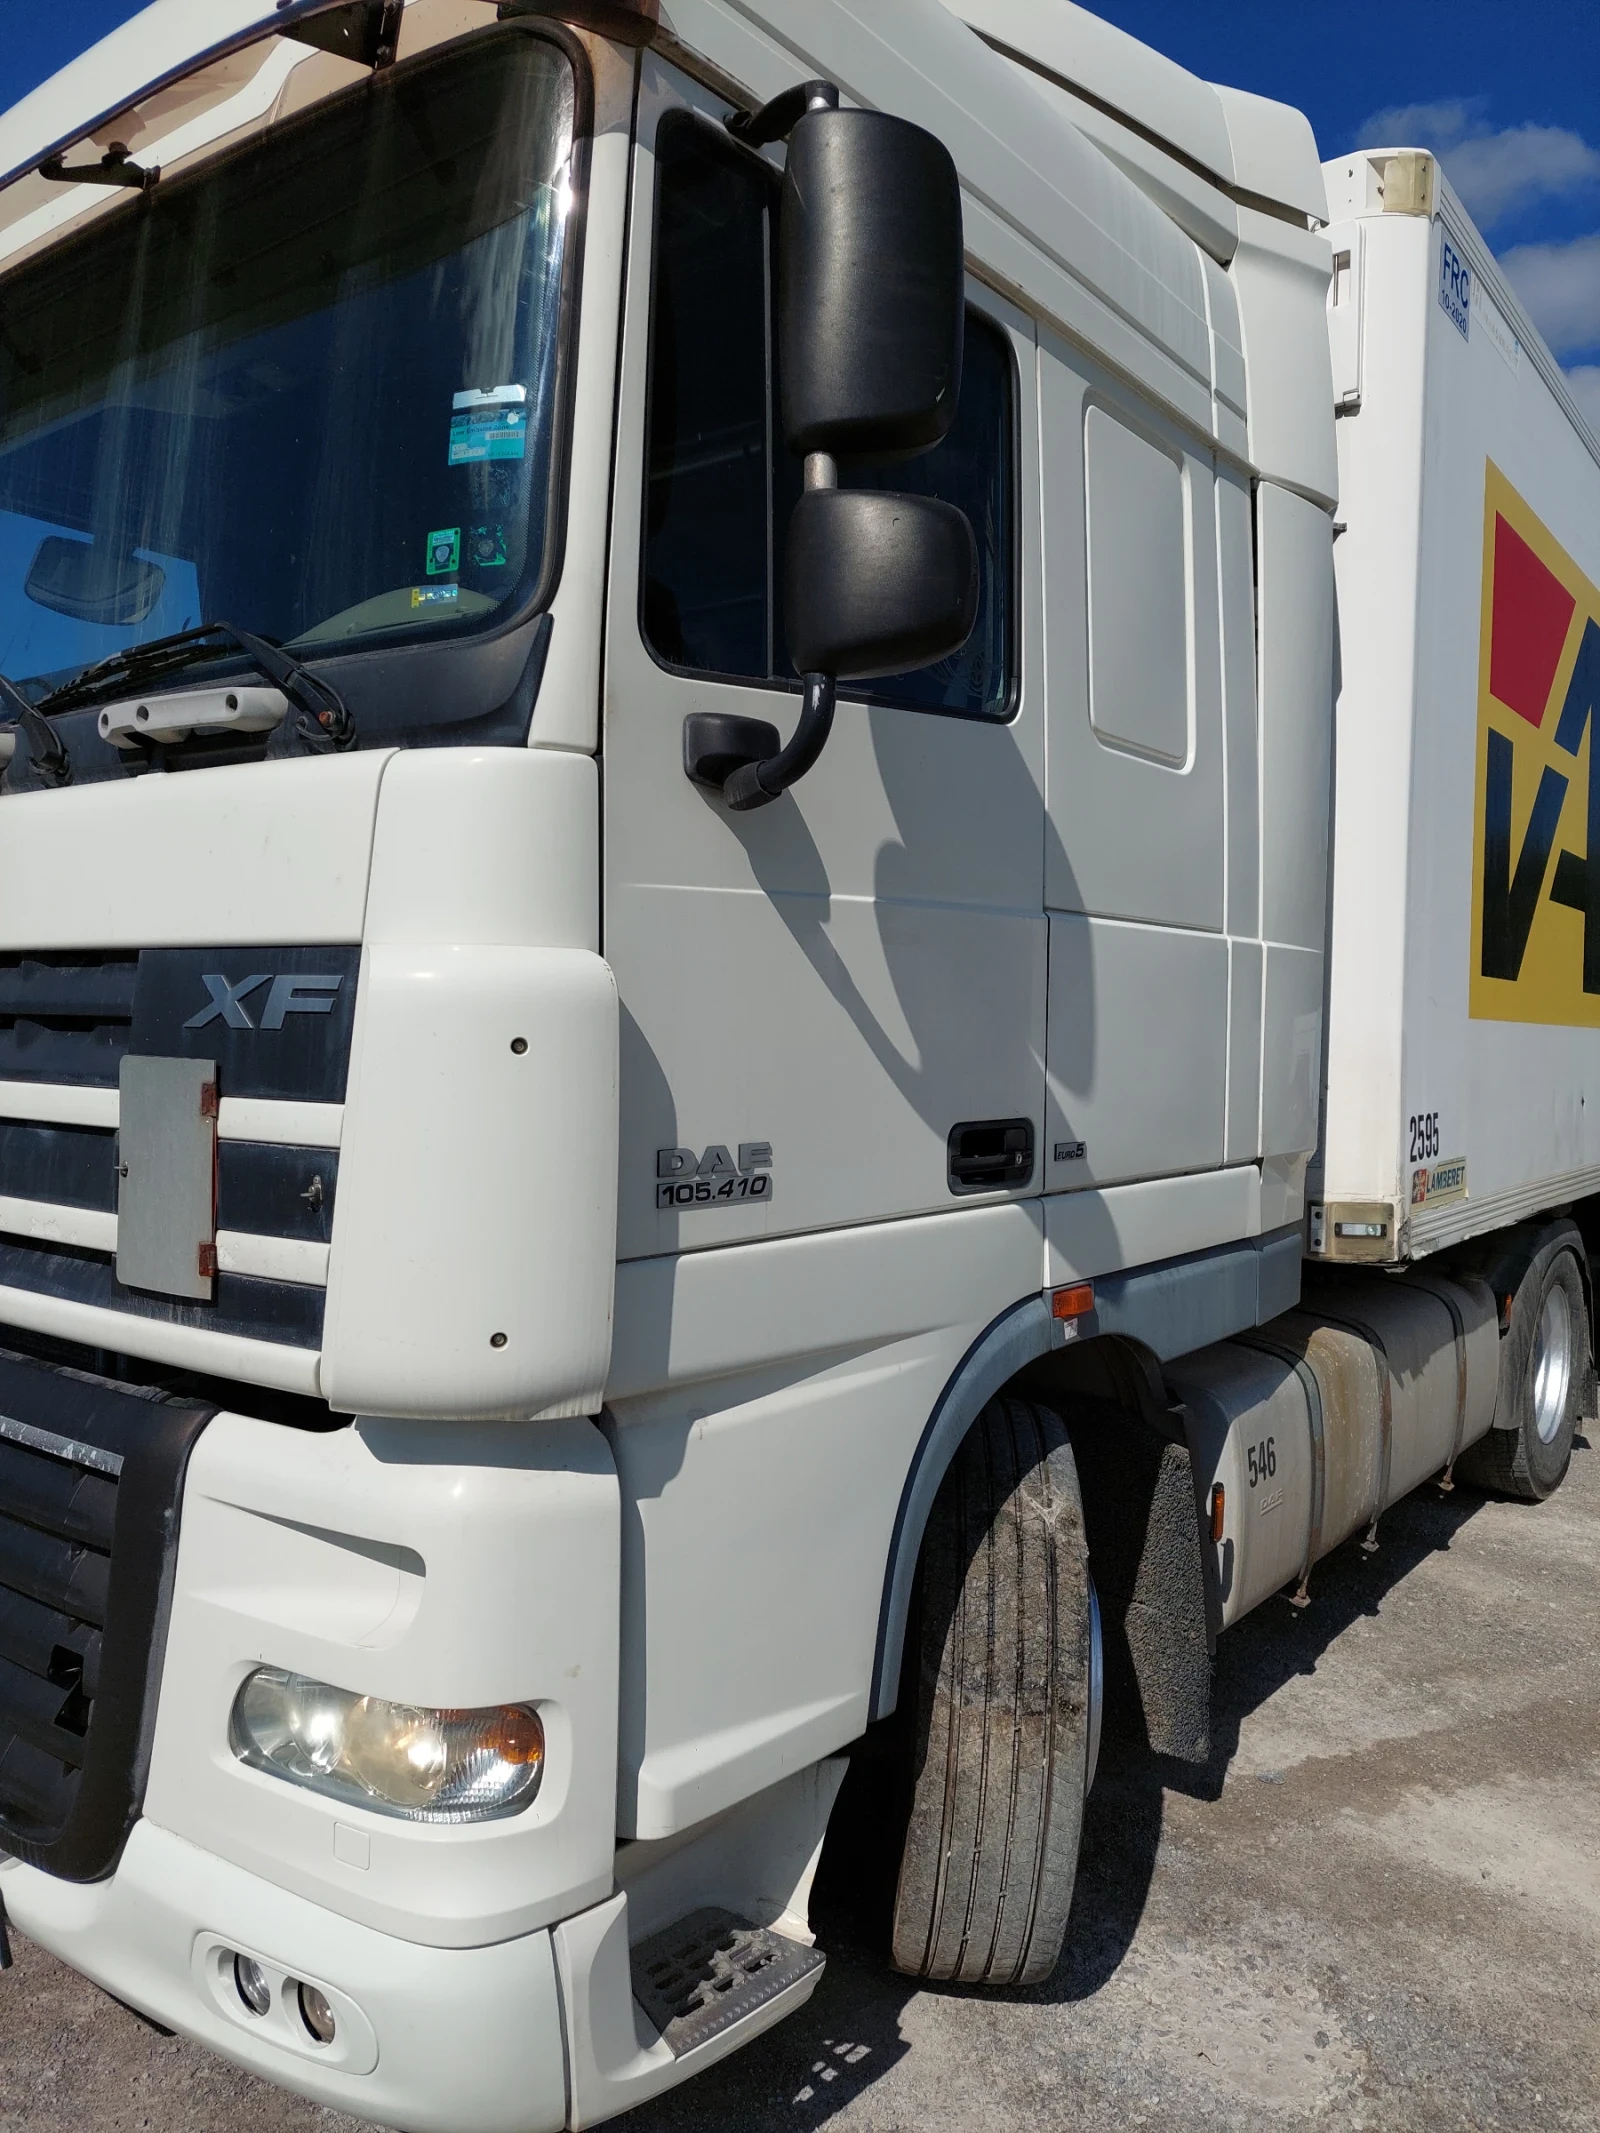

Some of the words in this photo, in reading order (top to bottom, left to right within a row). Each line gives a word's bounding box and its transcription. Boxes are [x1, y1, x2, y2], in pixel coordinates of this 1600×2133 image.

[1443, 242, 1469, 309] FRC
[1441, 289, 1467, 334] 10-2020
[466, 425, 493, 434] Emission
[493, 423, 510, 431] Zone
[182, 974, 344, 1030] XF
[657, 1142, 772, 1178] DAF
[1409, 1112, 1439, 1163] 2595
[661, 1176, 768, 1205] 105.410
[1426, 1166, 1465, 1193] LAMBERET
[1248, 1437, 1276, 1488] 546
